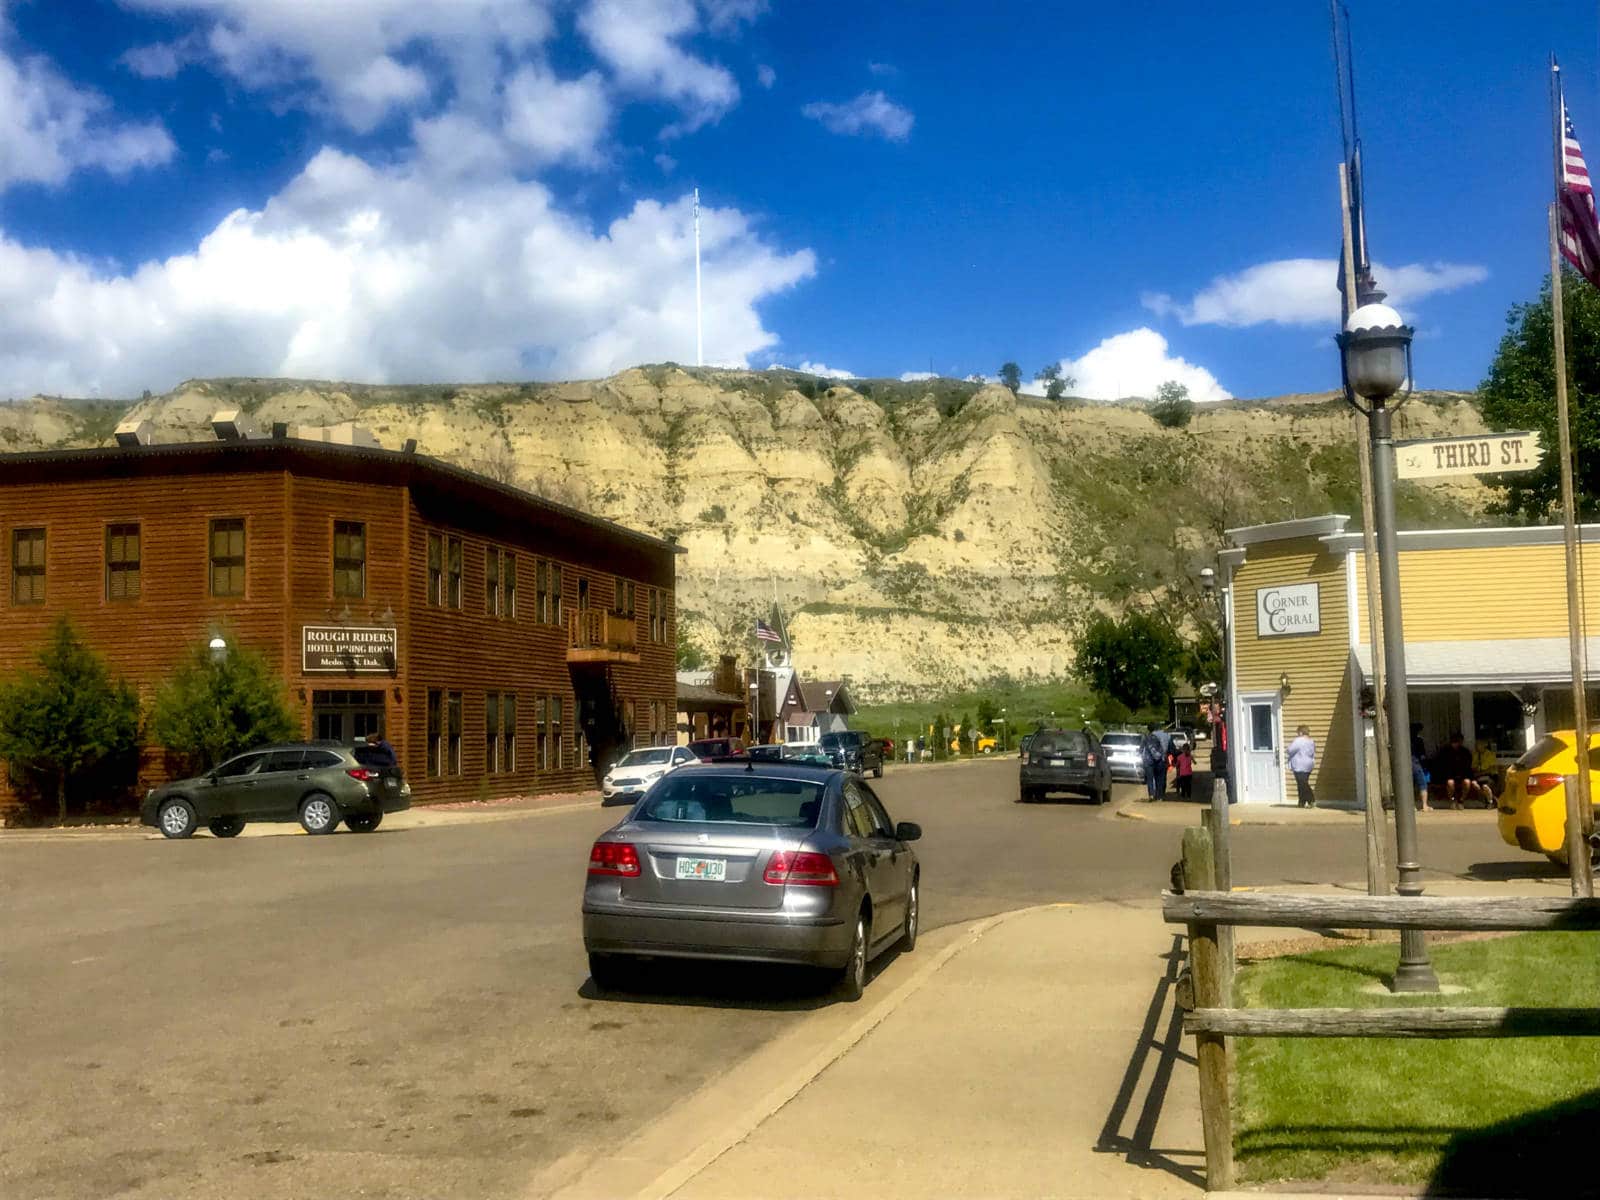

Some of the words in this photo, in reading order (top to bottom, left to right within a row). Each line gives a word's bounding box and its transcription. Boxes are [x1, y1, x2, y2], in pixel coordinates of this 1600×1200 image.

[1433, 441, 1490, 469] THIRD
[1500, 440, 1528, 465] ST.
[1263, 591, 1309, 615] CORNER
[1269, 608, 1313, 632] CORRAL
[307, 631, 350, 641] ROUGH
[353, 633, 393, 642] RIDERS
[307, 644, 334, 653] HOTEL
